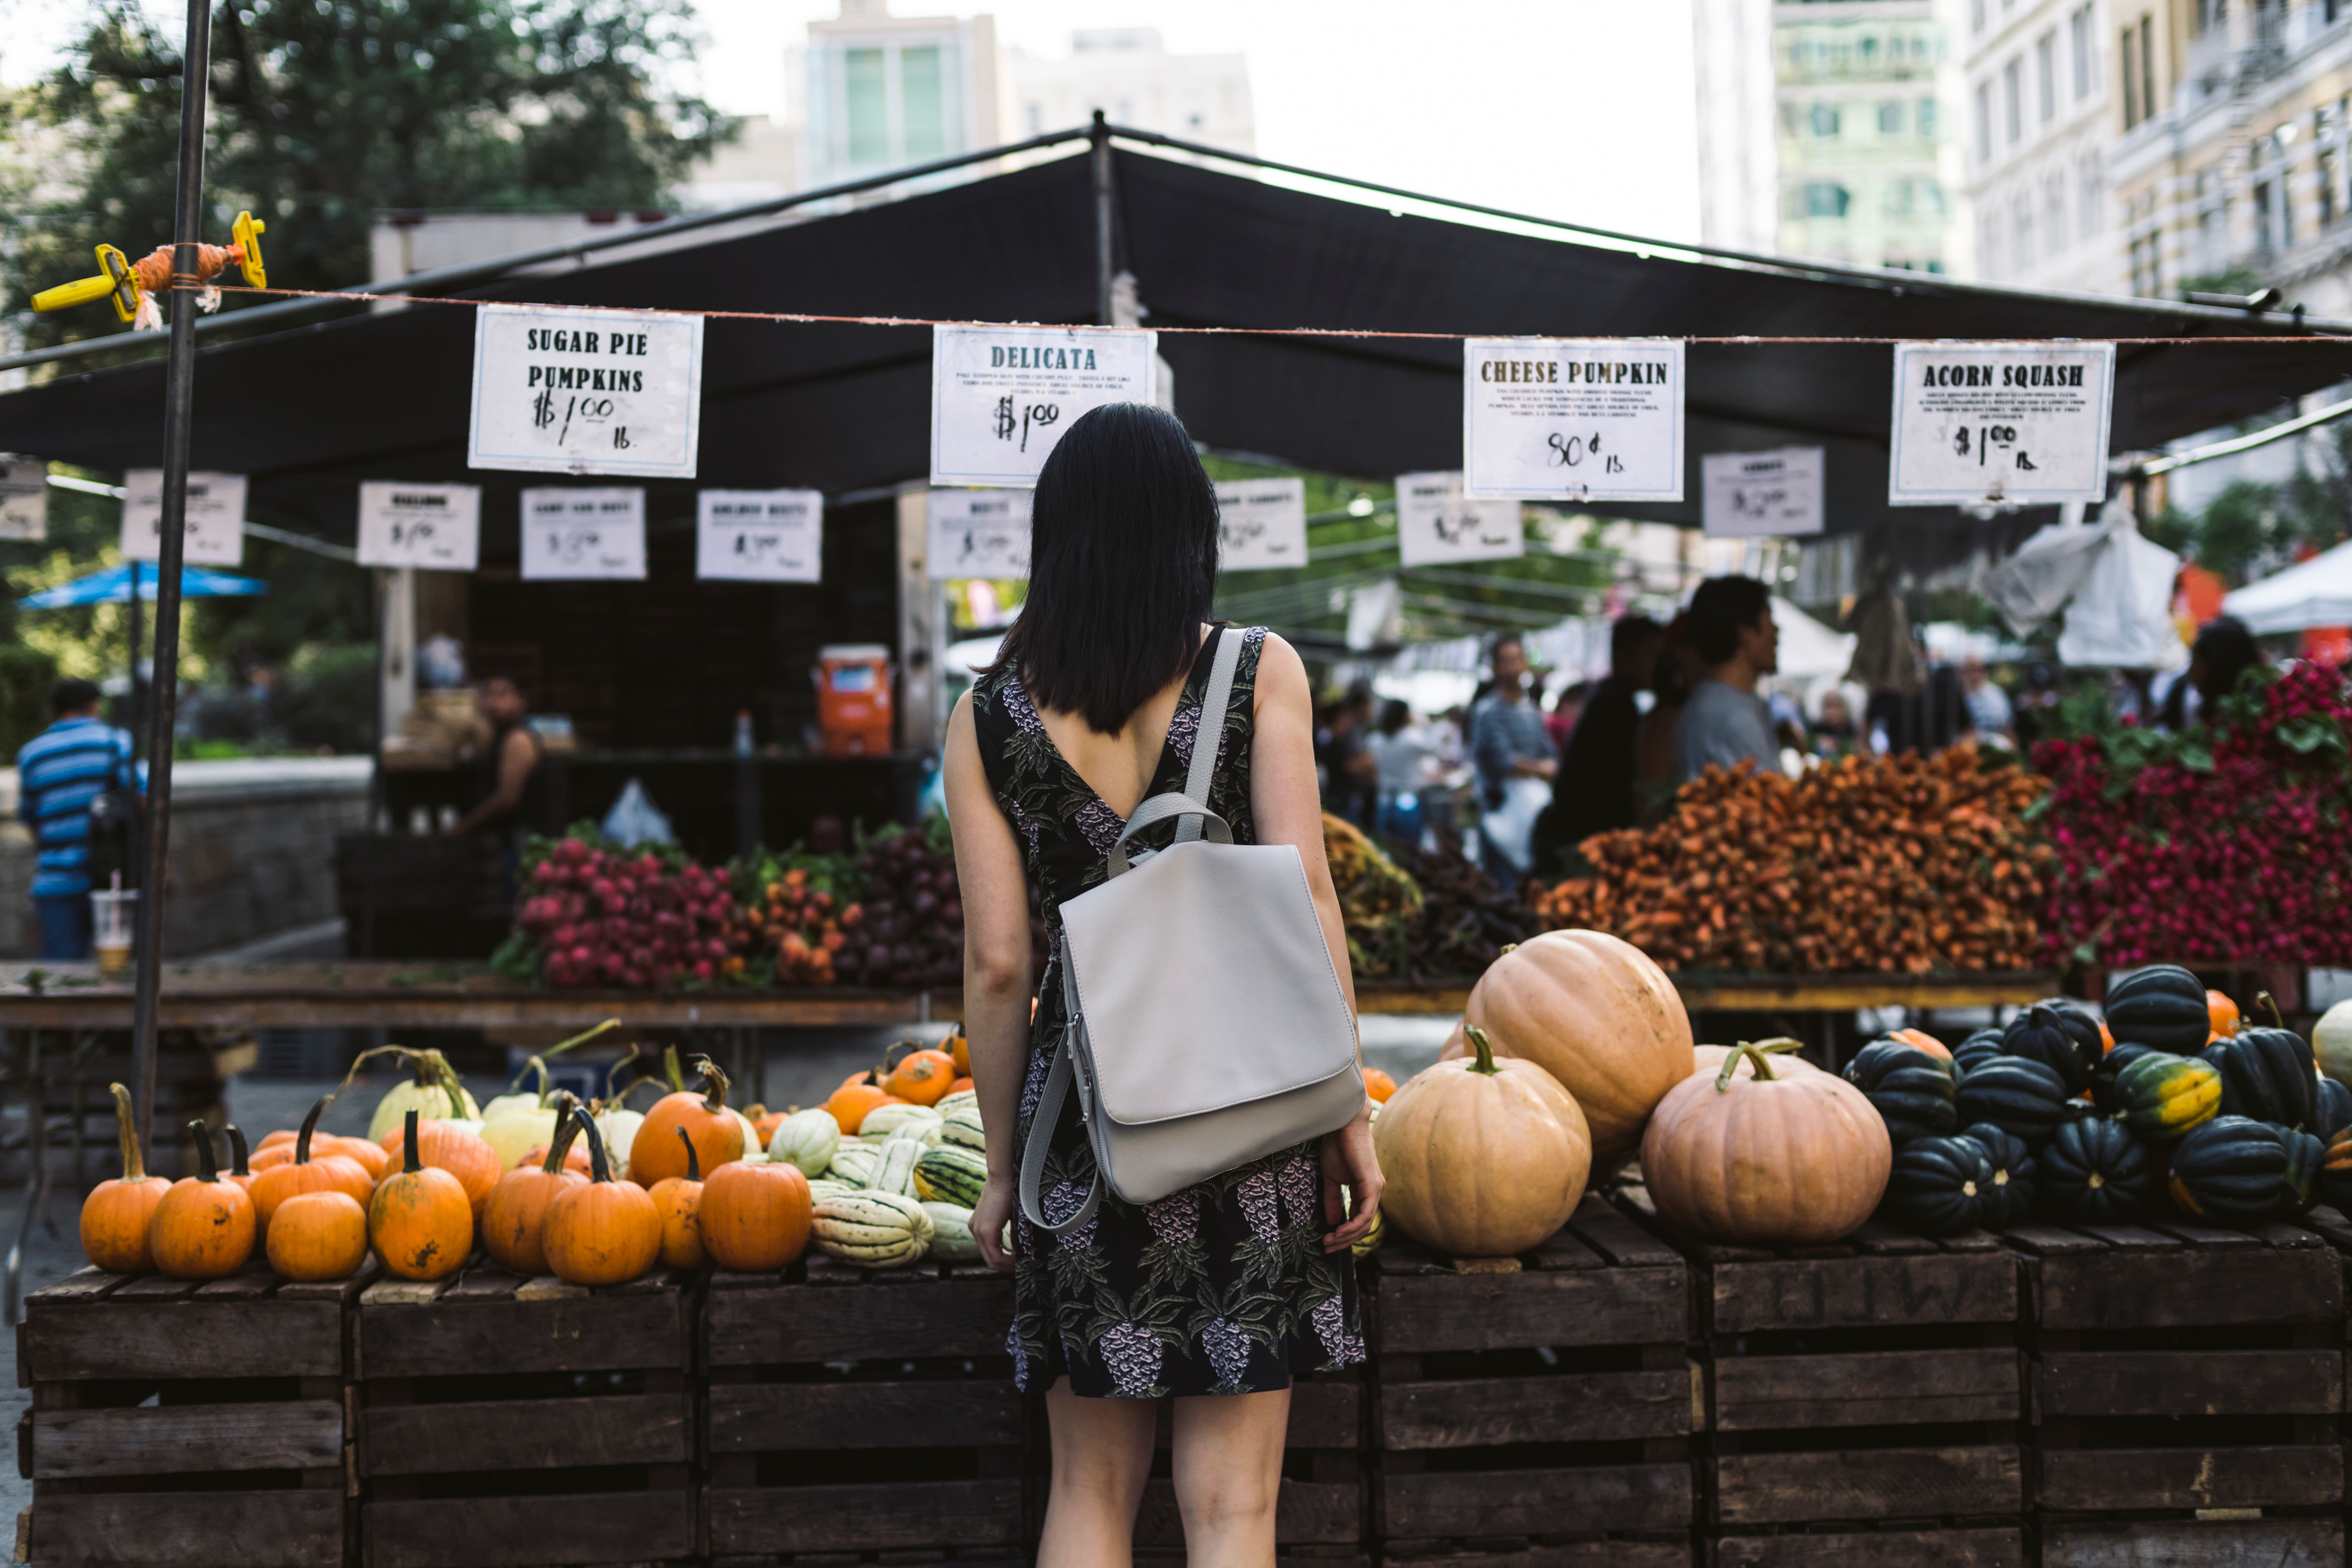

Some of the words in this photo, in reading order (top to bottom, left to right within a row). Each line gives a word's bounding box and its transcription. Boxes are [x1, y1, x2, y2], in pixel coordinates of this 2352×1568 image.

[528, 329, 599, 354] SUGAR
[610, 333, 647, 356] PIE
[991, 346, 1097, 370] DELICATA
[528, 366, 643, 392] PUMPKINS
[1481, 361, 1558, 383] CHEESE
[1569, 362, 1668, 384] PUMPKIN
[1924, 364, 1993, 387] ACORN
[2003, 364, 2084, 388] SQUASH
